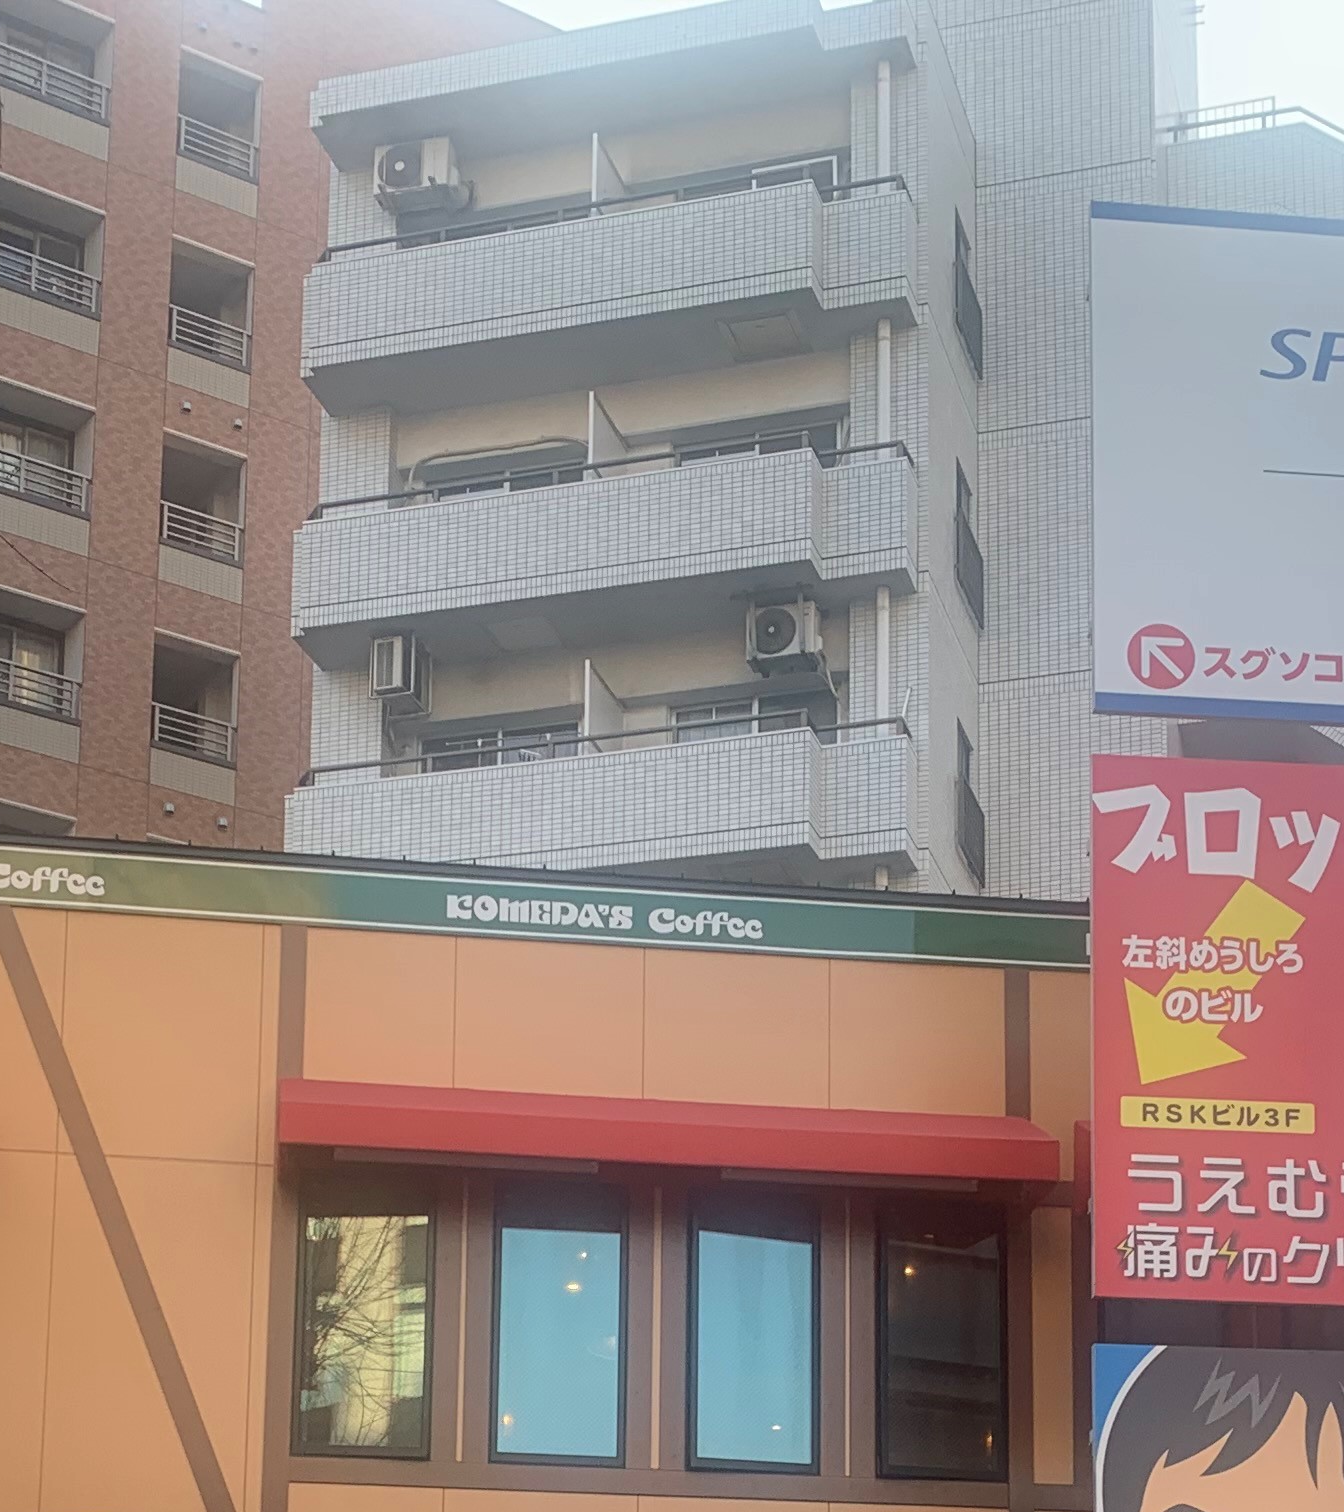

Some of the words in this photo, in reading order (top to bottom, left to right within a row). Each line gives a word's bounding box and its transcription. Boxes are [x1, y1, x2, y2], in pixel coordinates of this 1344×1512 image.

[1204, 643, 1344, 684] スグソコ
[447, 894, 633, 929] KOMEDA'S
[648, 908, 764, 939] Coffee
[1121, 934, 1305, 975] 左斜めうしろ
[1164, 989, 1264, 1024] のビル
[1142, 1104, 1301, 1129] RSKビル3F
